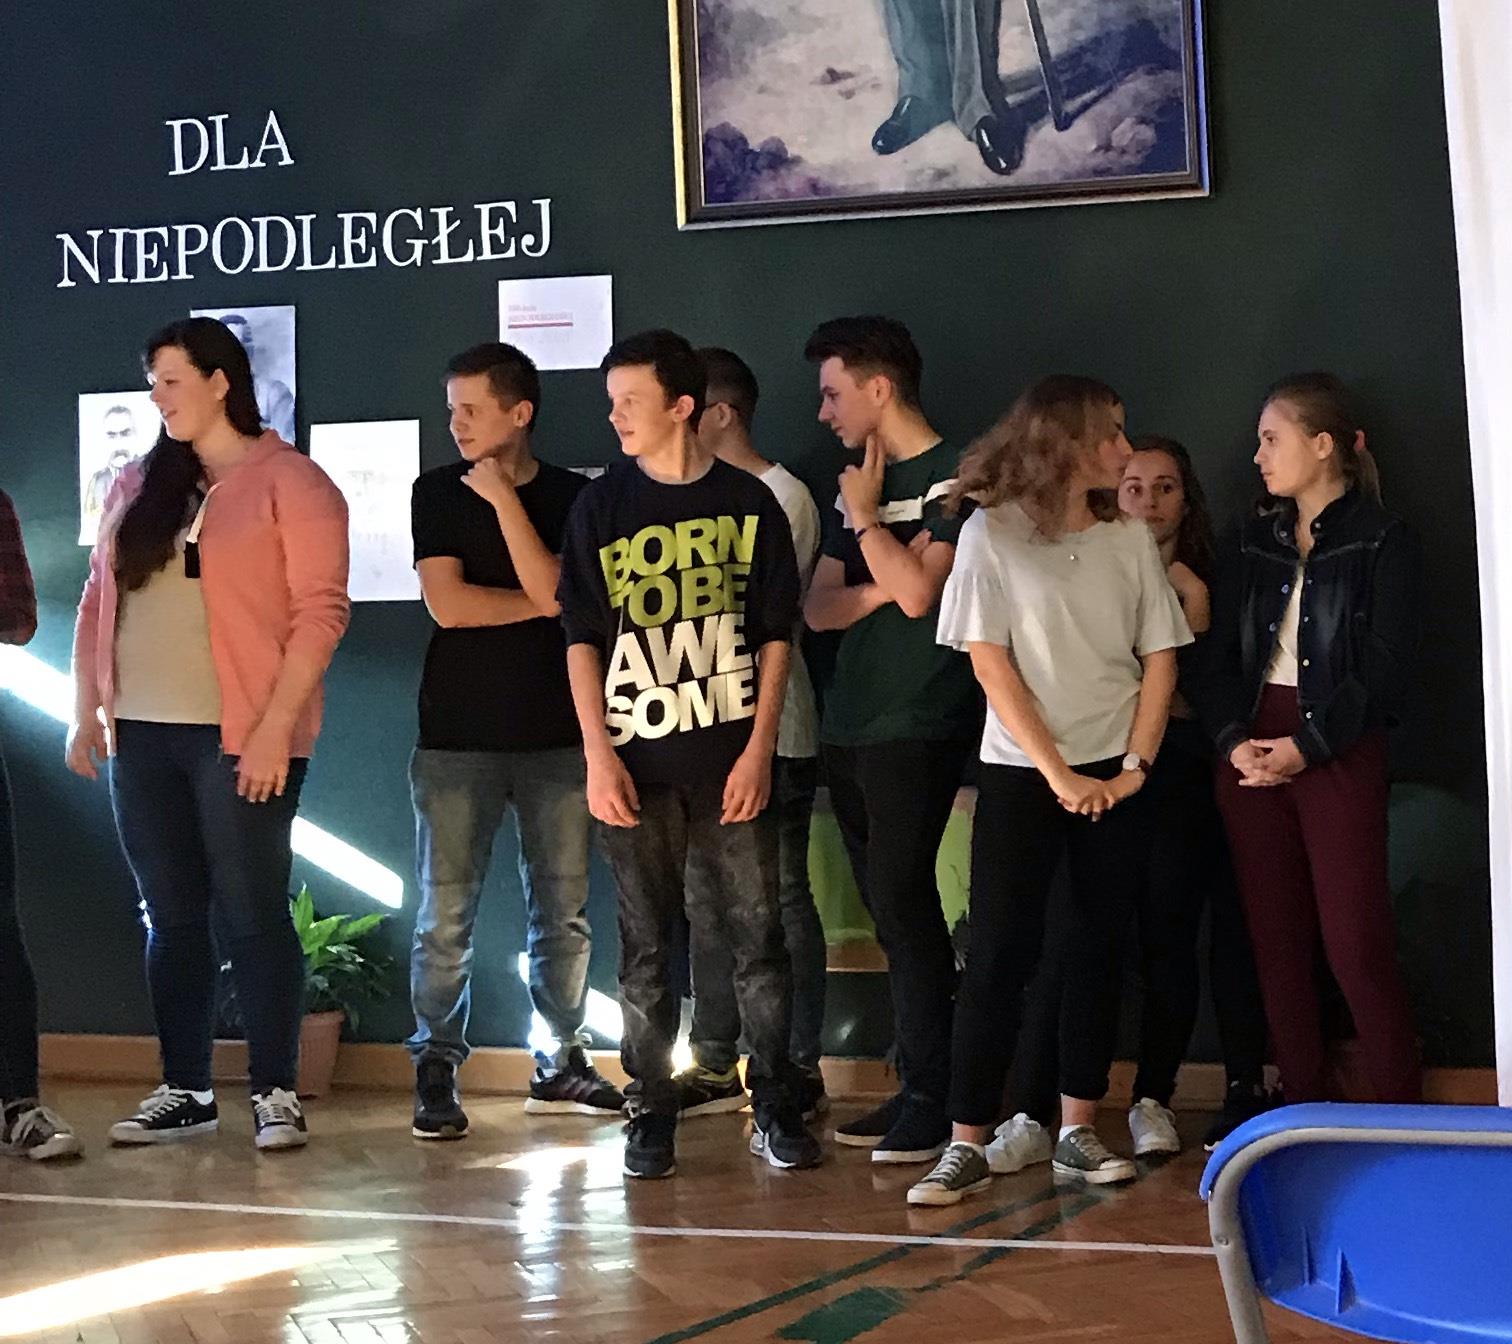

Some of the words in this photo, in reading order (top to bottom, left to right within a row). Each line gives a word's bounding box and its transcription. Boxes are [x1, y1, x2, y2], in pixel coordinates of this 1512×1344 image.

[166, 109, 295, 176] DLA
[55, 198, 552, 288] NIEPODLEGŁEJ
[598, 514, 759, 597] BORN
[680, 563, 752, 621] BE
[604, 612, 752, 699] AWE
[604, 667, 757, 747] SOME
